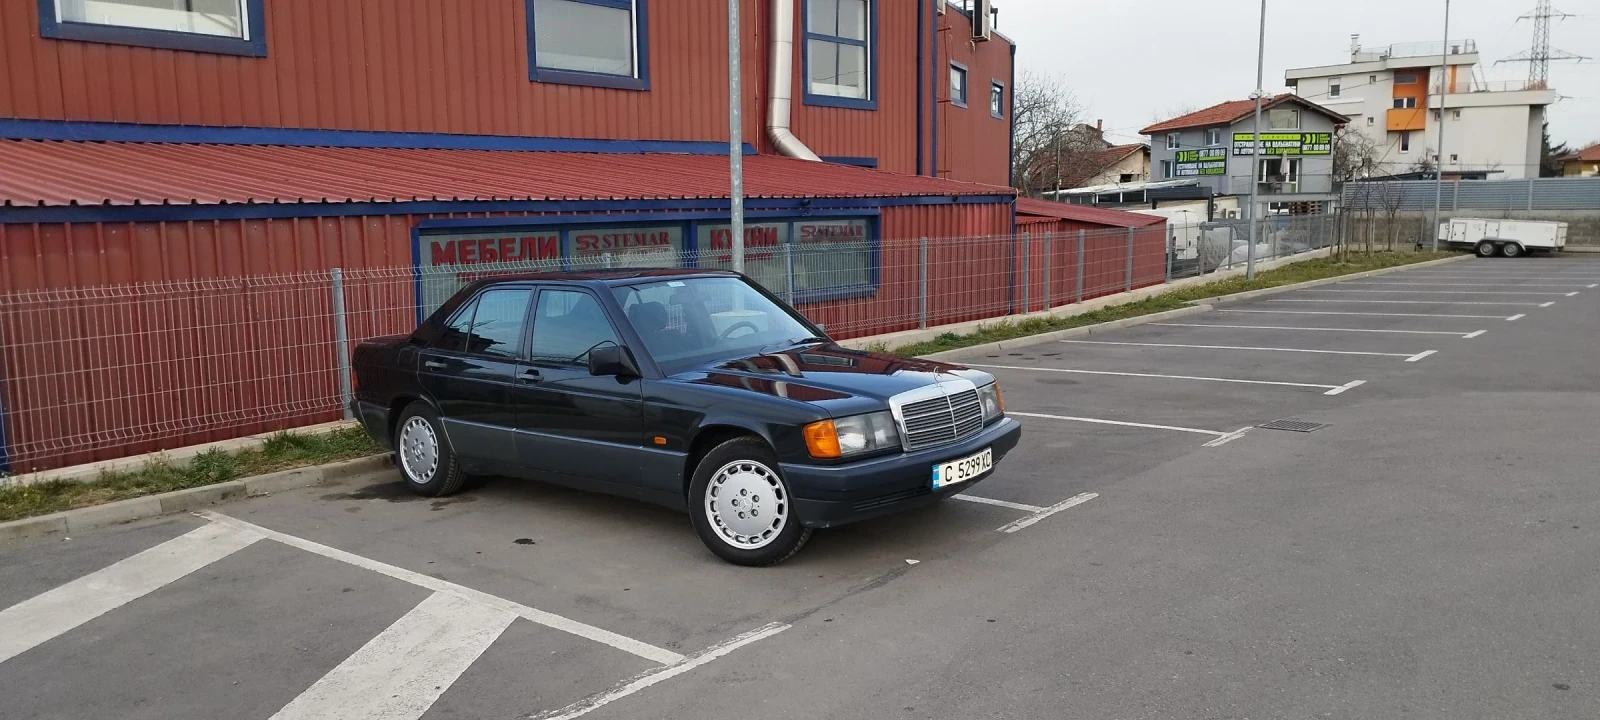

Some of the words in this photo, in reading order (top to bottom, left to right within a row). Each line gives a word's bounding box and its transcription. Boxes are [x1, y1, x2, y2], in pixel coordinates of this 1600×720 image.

[818, 224, 863, 237] STEMAR
[602, 231, 671, 249] STEMAR
[430, 235, 558, 267] МЕБЕЛИ
[945, 465, 953, 482] C
